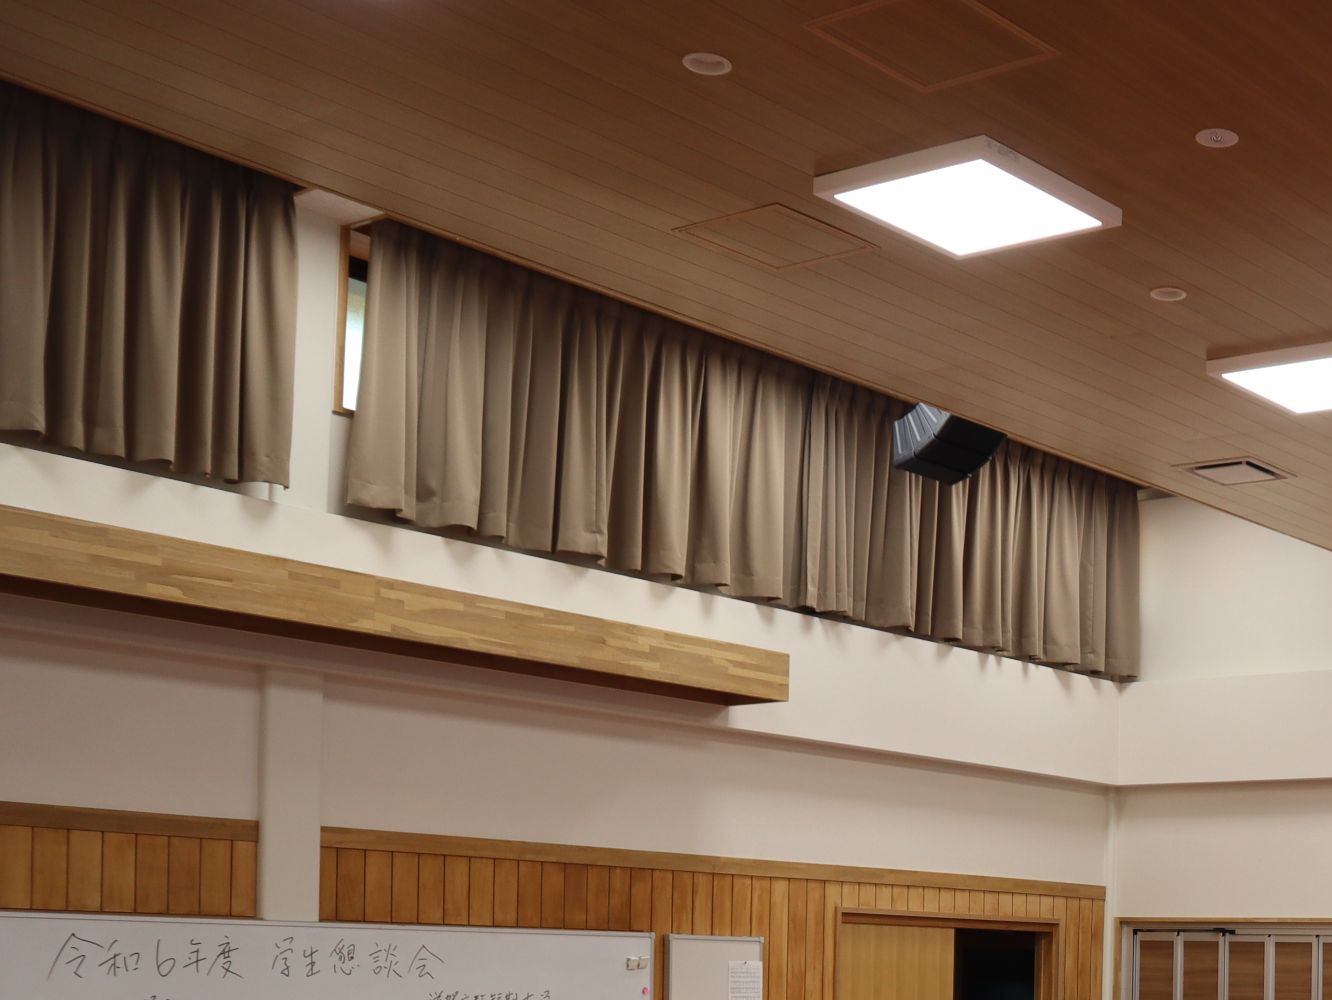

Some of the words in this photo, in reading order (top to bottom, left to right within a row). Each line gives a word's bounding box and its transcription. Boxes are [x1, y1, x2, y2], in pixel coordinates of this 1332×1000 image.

[47, 932, 244, 981] 令和6年度
[271, 936, 446, 980] 学生懇談会
